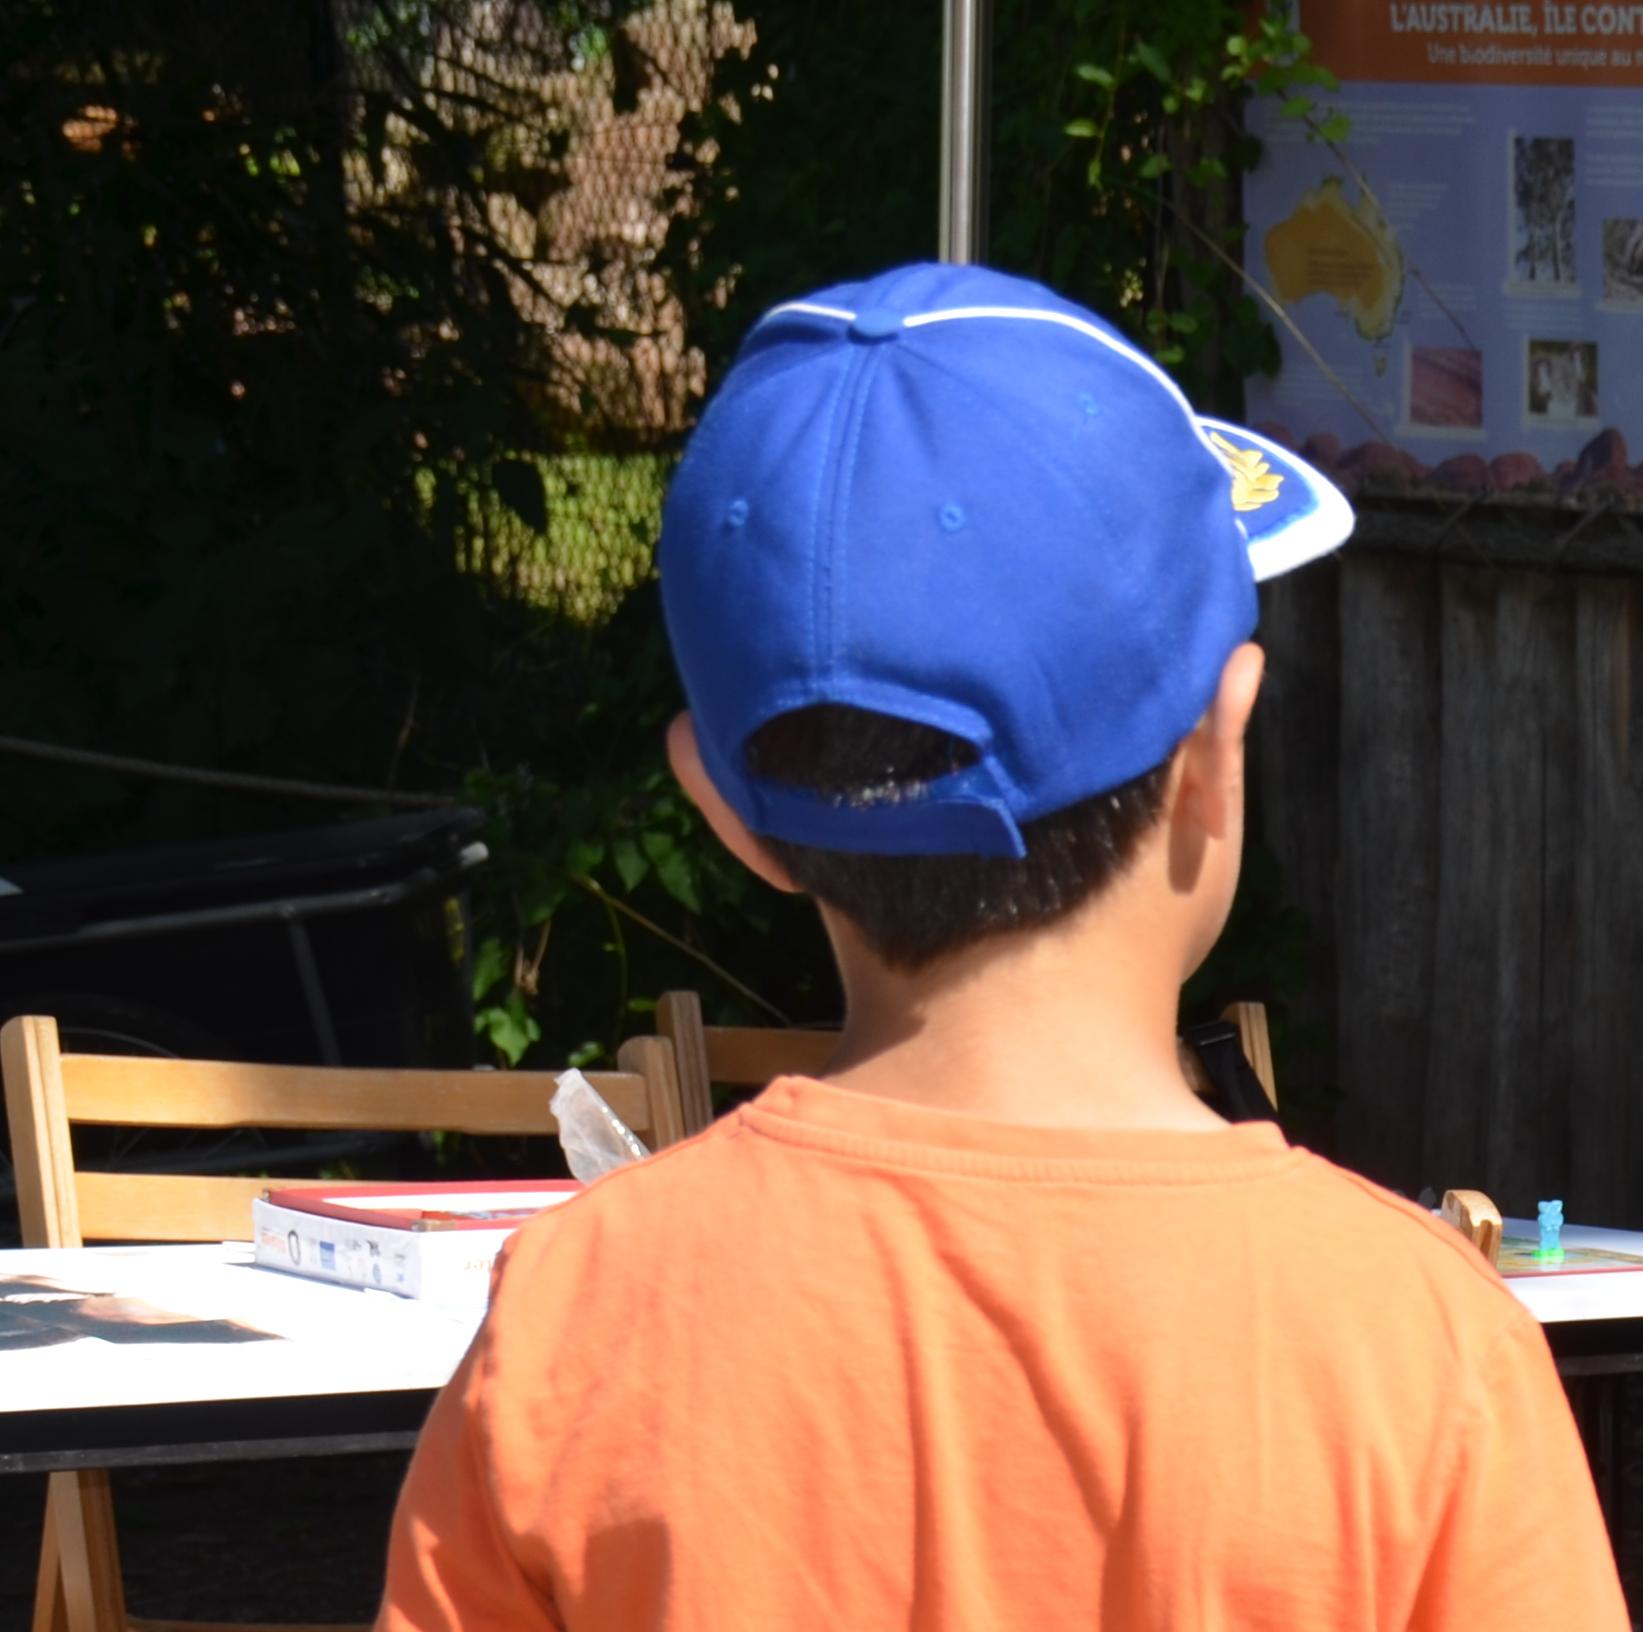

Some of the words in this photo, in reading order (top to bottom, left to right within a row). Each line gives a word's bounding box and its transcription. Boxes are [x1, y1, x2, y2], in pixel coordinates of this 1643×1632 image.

[1389, 3, 1538, 37] L'AUSTRALIE,
[1426, 42, 1456, 64] Une
[1458, 43, 1553, 66] biodiversité
[1555, 49, 1608, 71] unique
[1610, 49, 1632, 66] au
